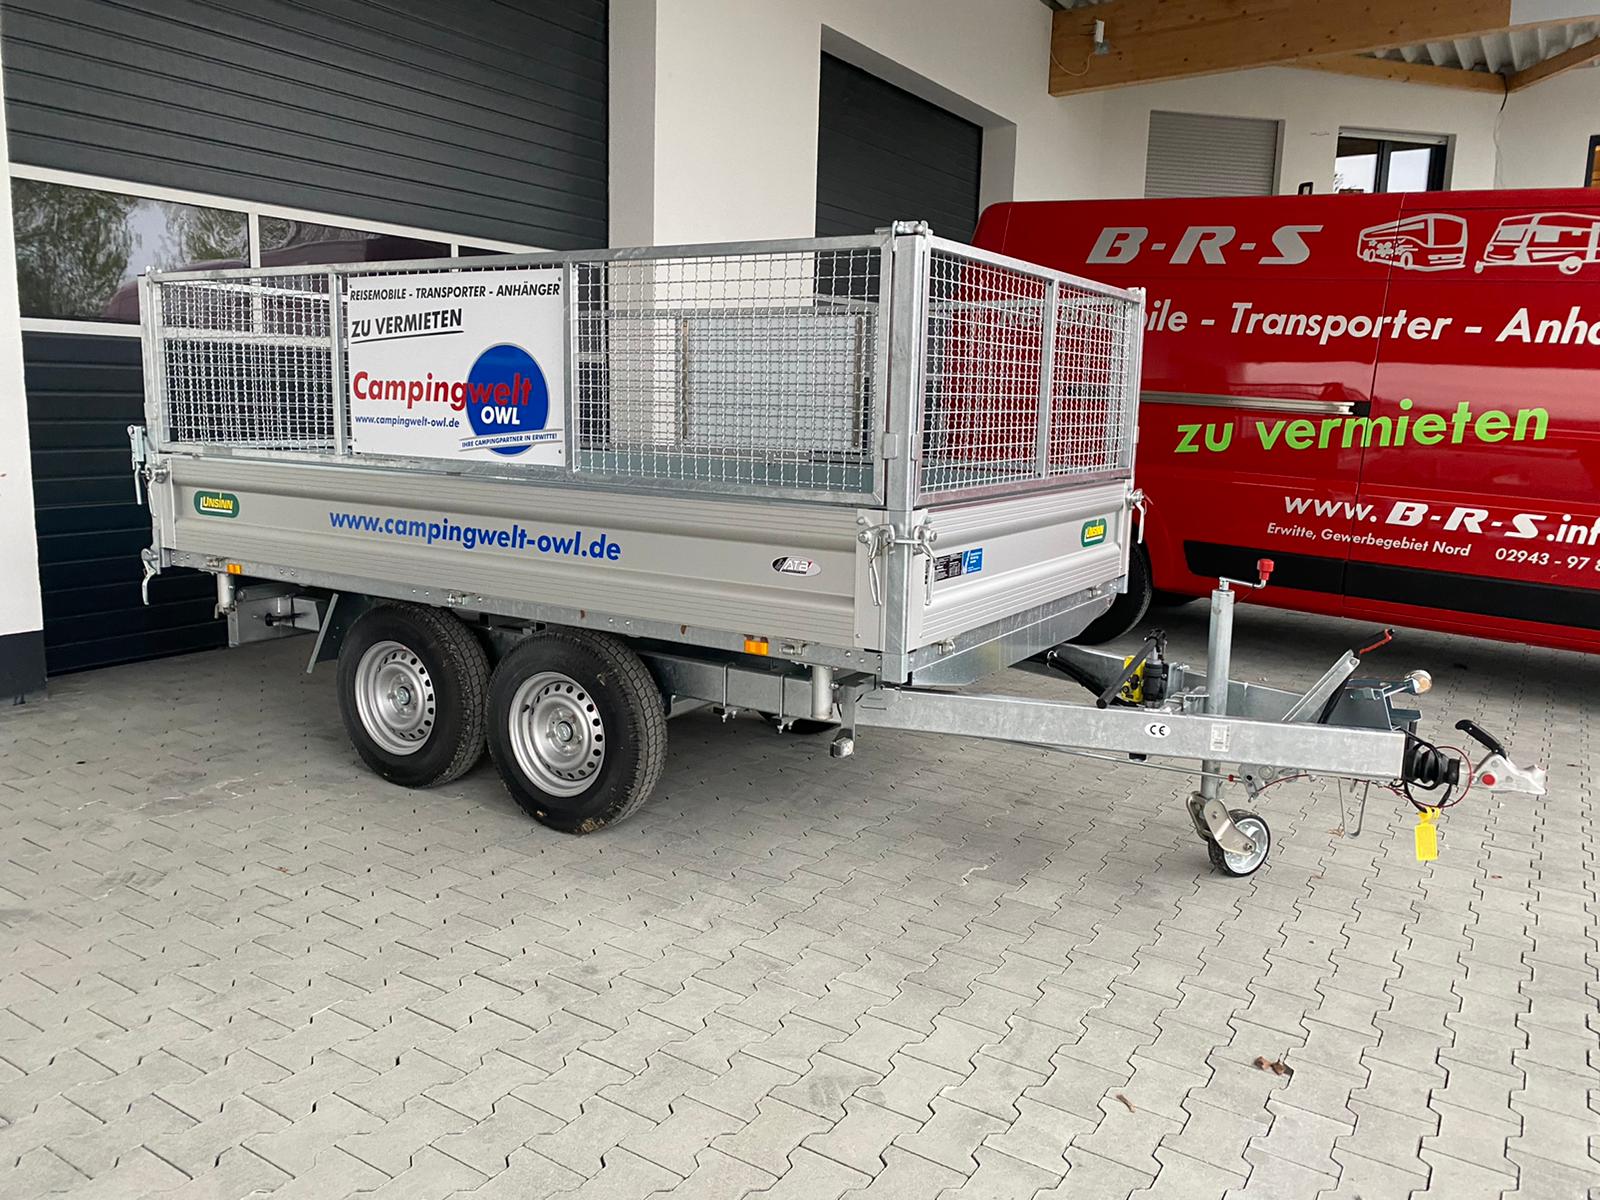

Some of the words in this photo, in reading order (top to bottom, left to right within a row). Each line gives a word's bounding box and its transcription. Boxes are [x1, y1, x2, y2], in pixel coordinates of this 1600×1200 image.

[350, 288, 406, 300] REISEMOBILE
[416, 285, 486, 298] TRANSPORTER
[496, 281, 560, 296] ANHÄNGER
[351, 320, 371, 338] ZU
[375, 308, 462, 335] VERMIETEN
[1231, 302, 1453, 345] Transporter
[353, 371, 532, 411] Campingwelt
[355, 415, 460, 428] www.campingwelt-owl.de
[481, 406, 521, 425] OWL
[1174, 422, 1234, 454] zu
[1255, 398, 1550, 451] vermieten
[475, 435, 523, 446] CAMPINGPARTNER
[329, 511, 621, 561] www.campingwelt-owl.de
[1267, 522, 1317, 541] Erwitte,
[1321, 529, 1429, 551] Gewerbegebiet
[1432, 540, 1472, 557] Nord
[1495, 547, 1550, 566] 02943
[1567, 555, 1591, 571] 97
